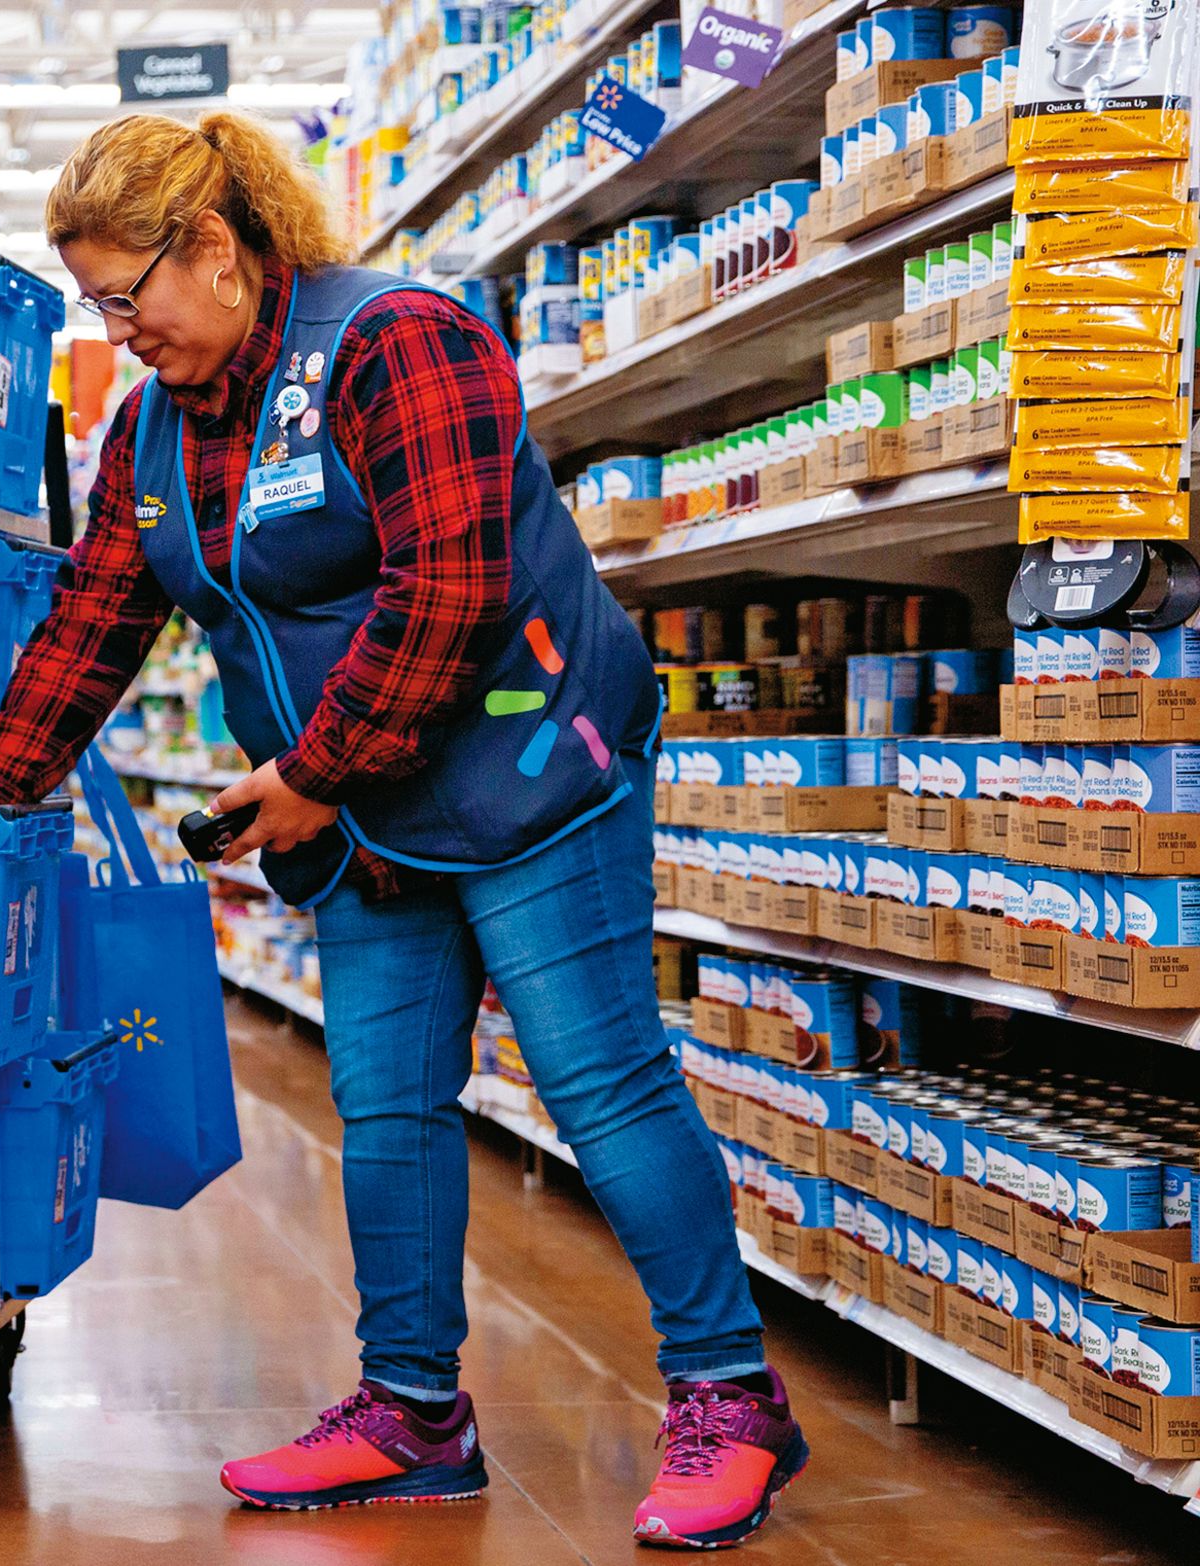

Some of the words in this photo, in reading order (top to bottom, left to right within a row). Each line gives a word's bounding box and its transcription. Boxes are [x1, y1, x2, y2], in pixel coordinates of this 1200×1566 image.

[699, 16, 774, 54] Organic
[143, 52, 202, 75] Canned
[133, 74, 213, 97] Vegetables
[1046, 104, 1073, 113] Quick
[1074, 102, 1082, 110] &
[1106, 100, 1132, 109] Clean
[1134, 99, 1148, 109] Up
[582, 110, 612, 136] Low
[609, 127, 643, 156] Price
[1030, 189, 1037, 201] 6
[1040, 243, 1048, 254] 6
[1024, 282, 1031, 293] 6
[1022, 329, 1029, 339] 6
[1023, 376, 1030, 386] 6
[1032, 429, 1039, 440] 6
[1023, 470, 1030, 480] 6
[264, 480, 311, 499] RAQUEL
[1033, 521, 1040, 531] 6
[1109, 647, 1125, 656] Red
[1158, 698, 1169, 706] STK
[1093, 777, 1110, 786] Red
[1158, 841, 1169, 849] STK
[1131, 912, 1147, 921] Red
[1149, 955, 1171, 964] 12/15.5
[1149, 964, 1161, 973] STK
[1162, 964, 1171, 973] NO
[1178, 1199, 1191, 1208] Da
[1087, 1336, 1101, 1346] Red
[1114, 1345, 1129, 1356] Dark
[1145, 1361, 1160, 1372] Red
[1168, 1429, 1180, 1438] STK
[1180, 1429, 1190, 1438] NO
